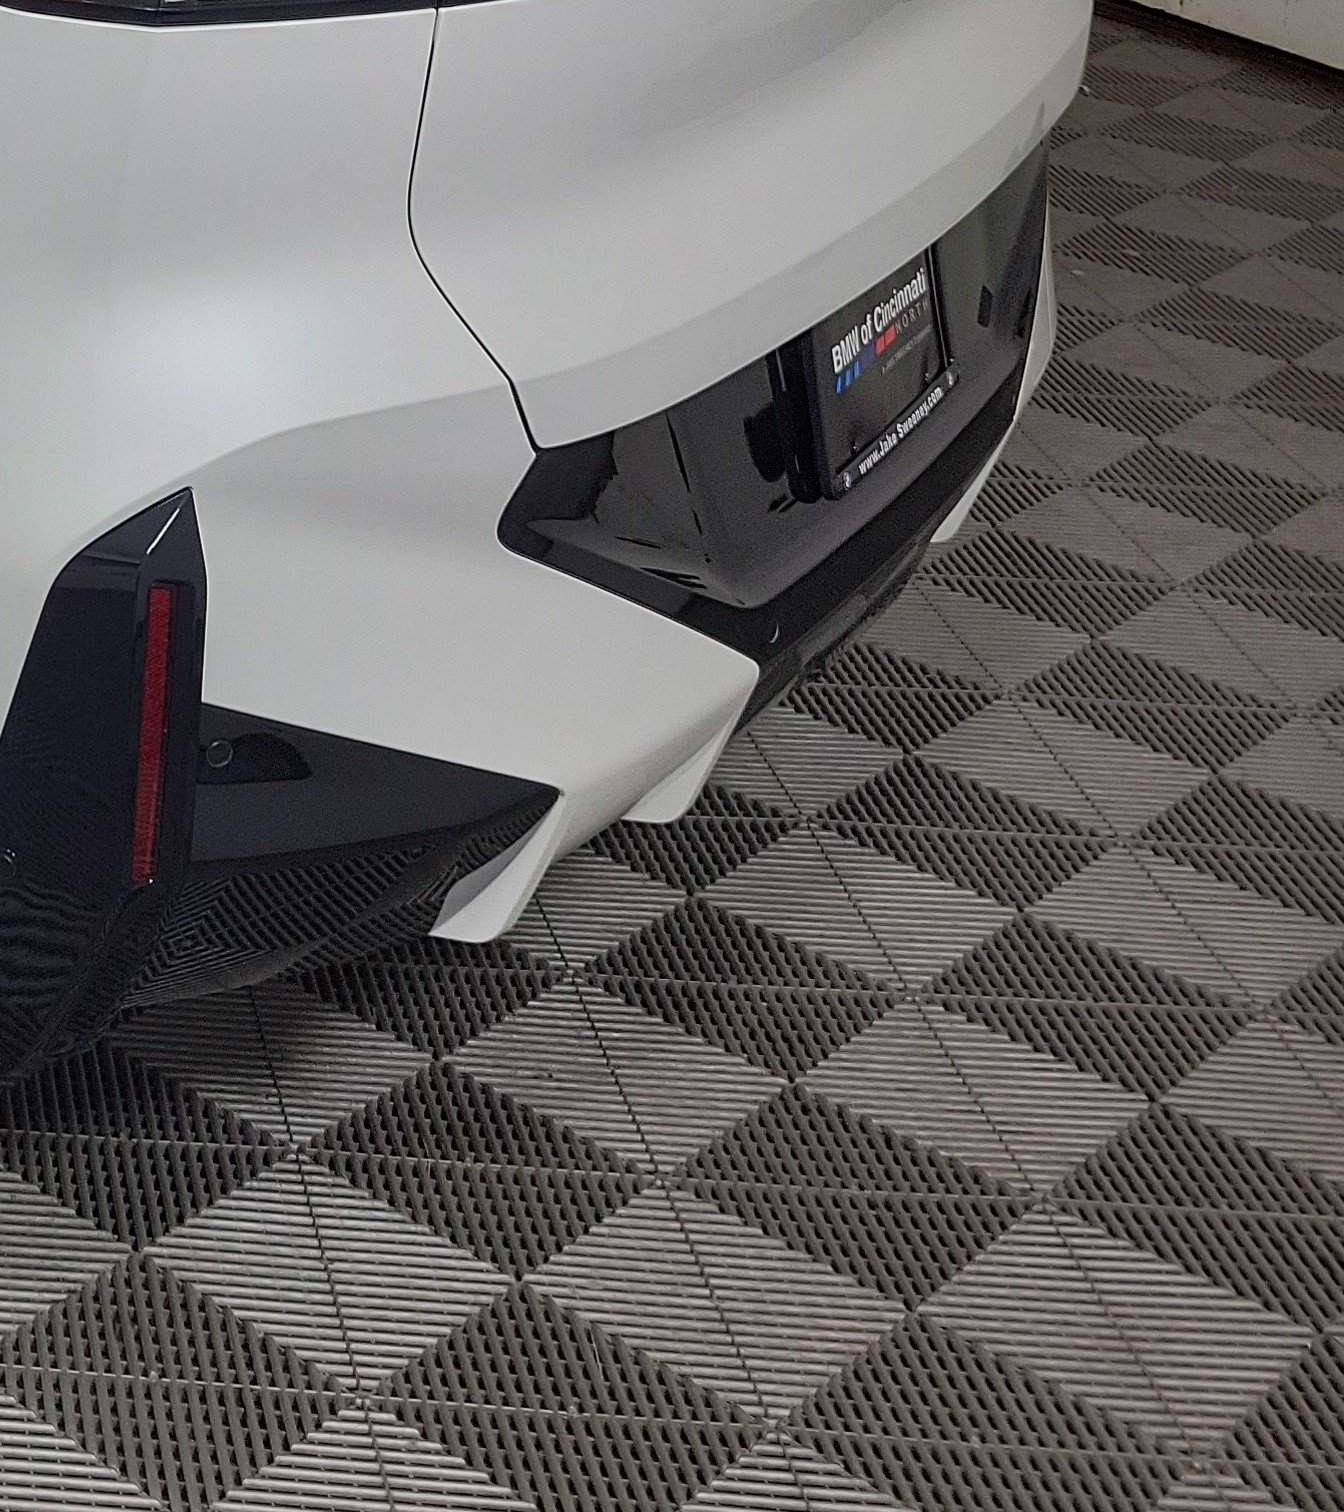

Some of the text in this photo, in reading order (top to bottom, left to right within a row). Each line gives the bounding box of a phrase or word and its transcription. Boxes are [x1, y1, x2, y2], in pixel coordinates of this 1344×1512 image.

[832, 325, 860, 374] BMW
[861, 313, 873, 345] of
[874, 267, 927, 332] Cincinnati
[894, 296, 929, 335] NORTH
